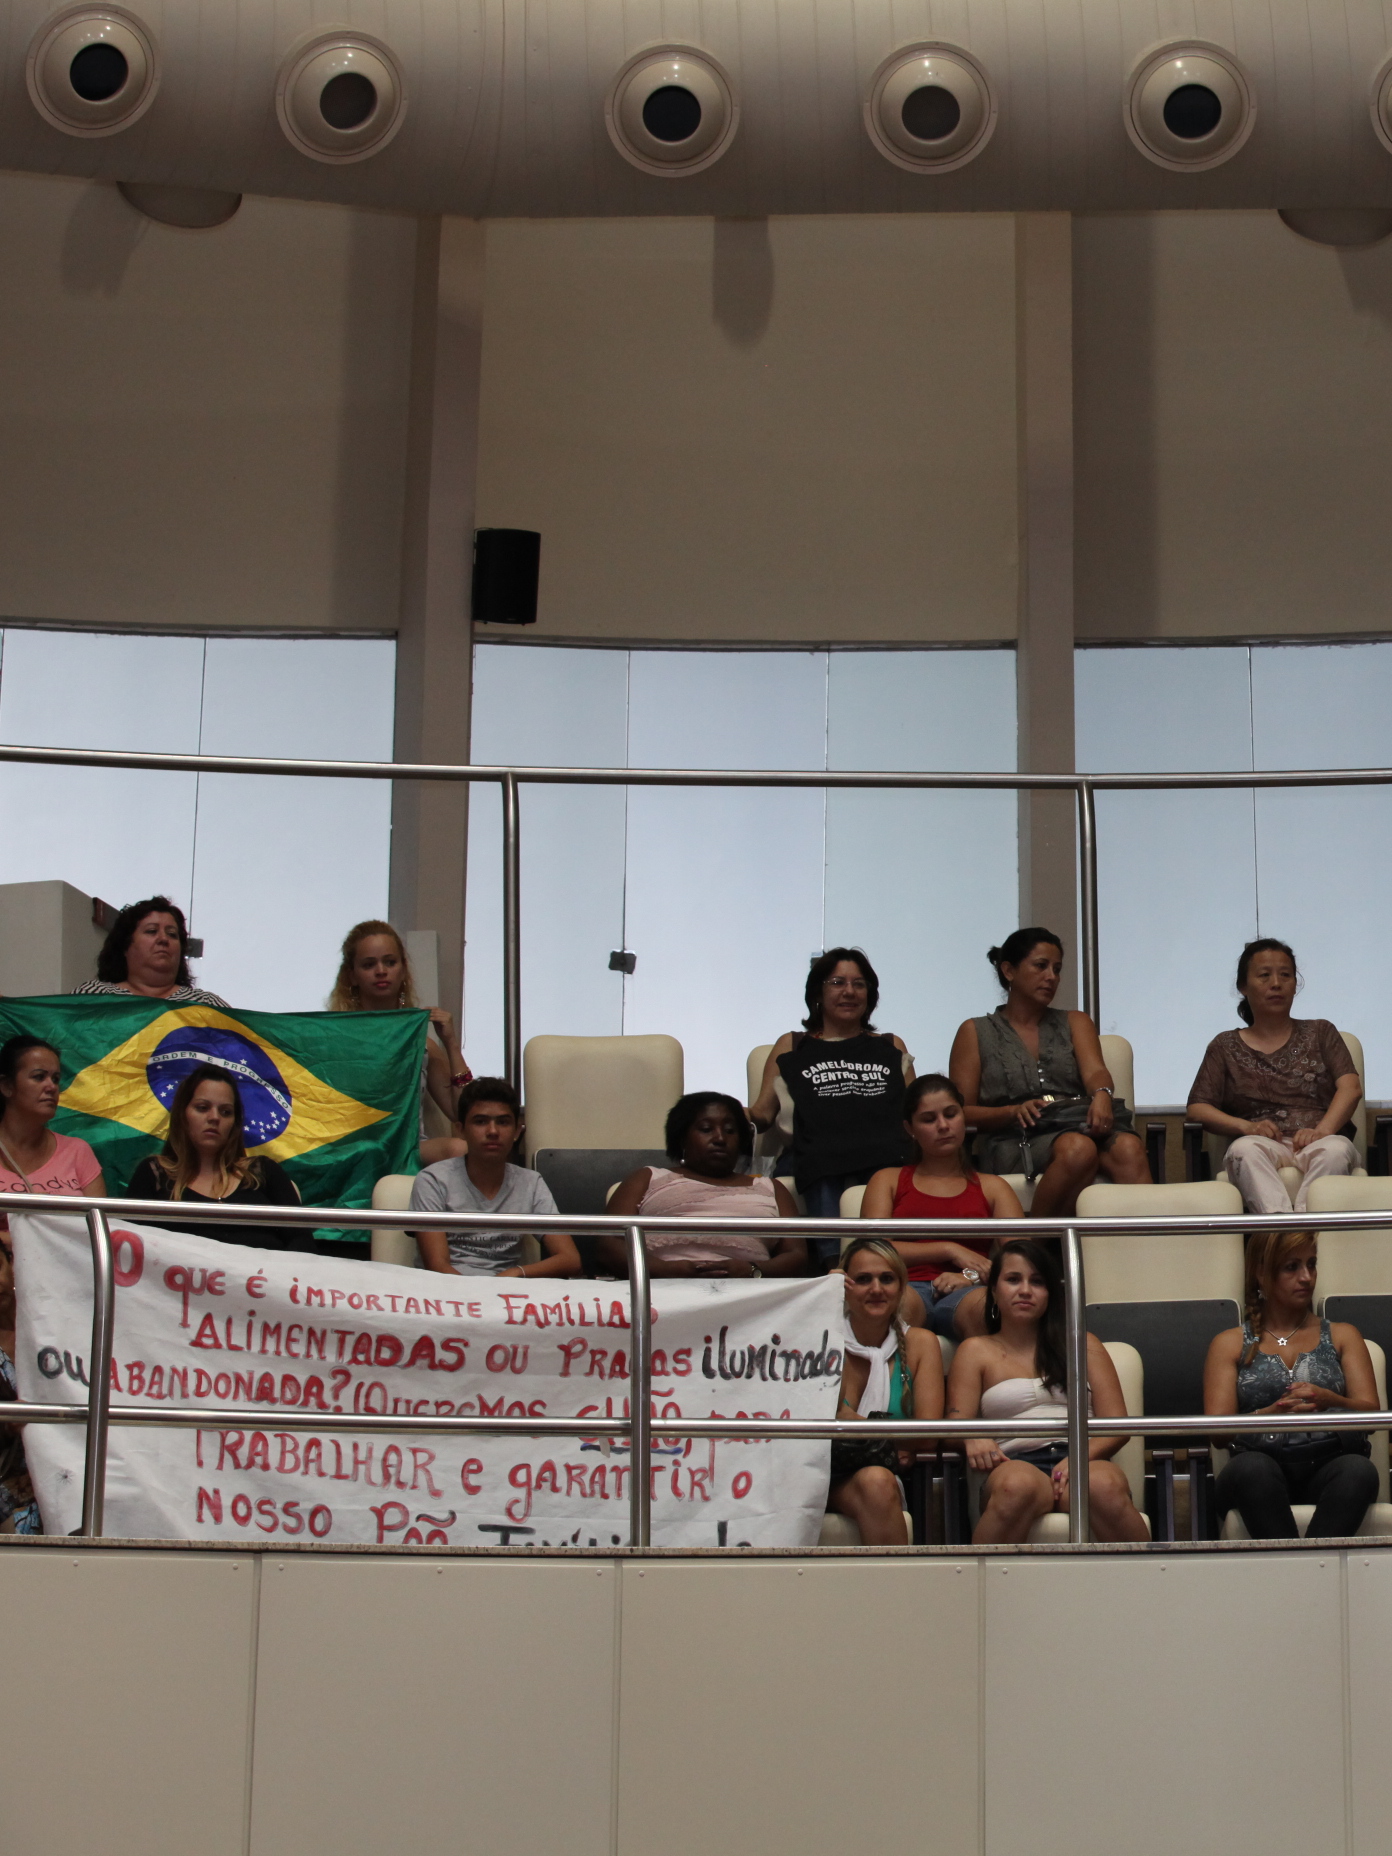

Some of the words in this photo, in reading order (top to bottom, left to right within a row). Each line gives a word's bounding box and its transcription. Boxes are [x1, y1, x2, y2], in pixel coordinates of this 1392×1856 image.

[152, 1050, 198, 1062] ORDEM
[207, 1055, 214, 1064] E
[222, 1059, 290, 1110] PROGRESSO
[811, 1070, 859, 1085] CENTRO
[861, 1071, 885, 1082] SUL
[110, 1229, 145, 1288] O
[485, 1343, 530, 1375] OU
[556, 1337, 694, 1380] PRAAS
[195, 1486, 333, 1536] NOSSO
